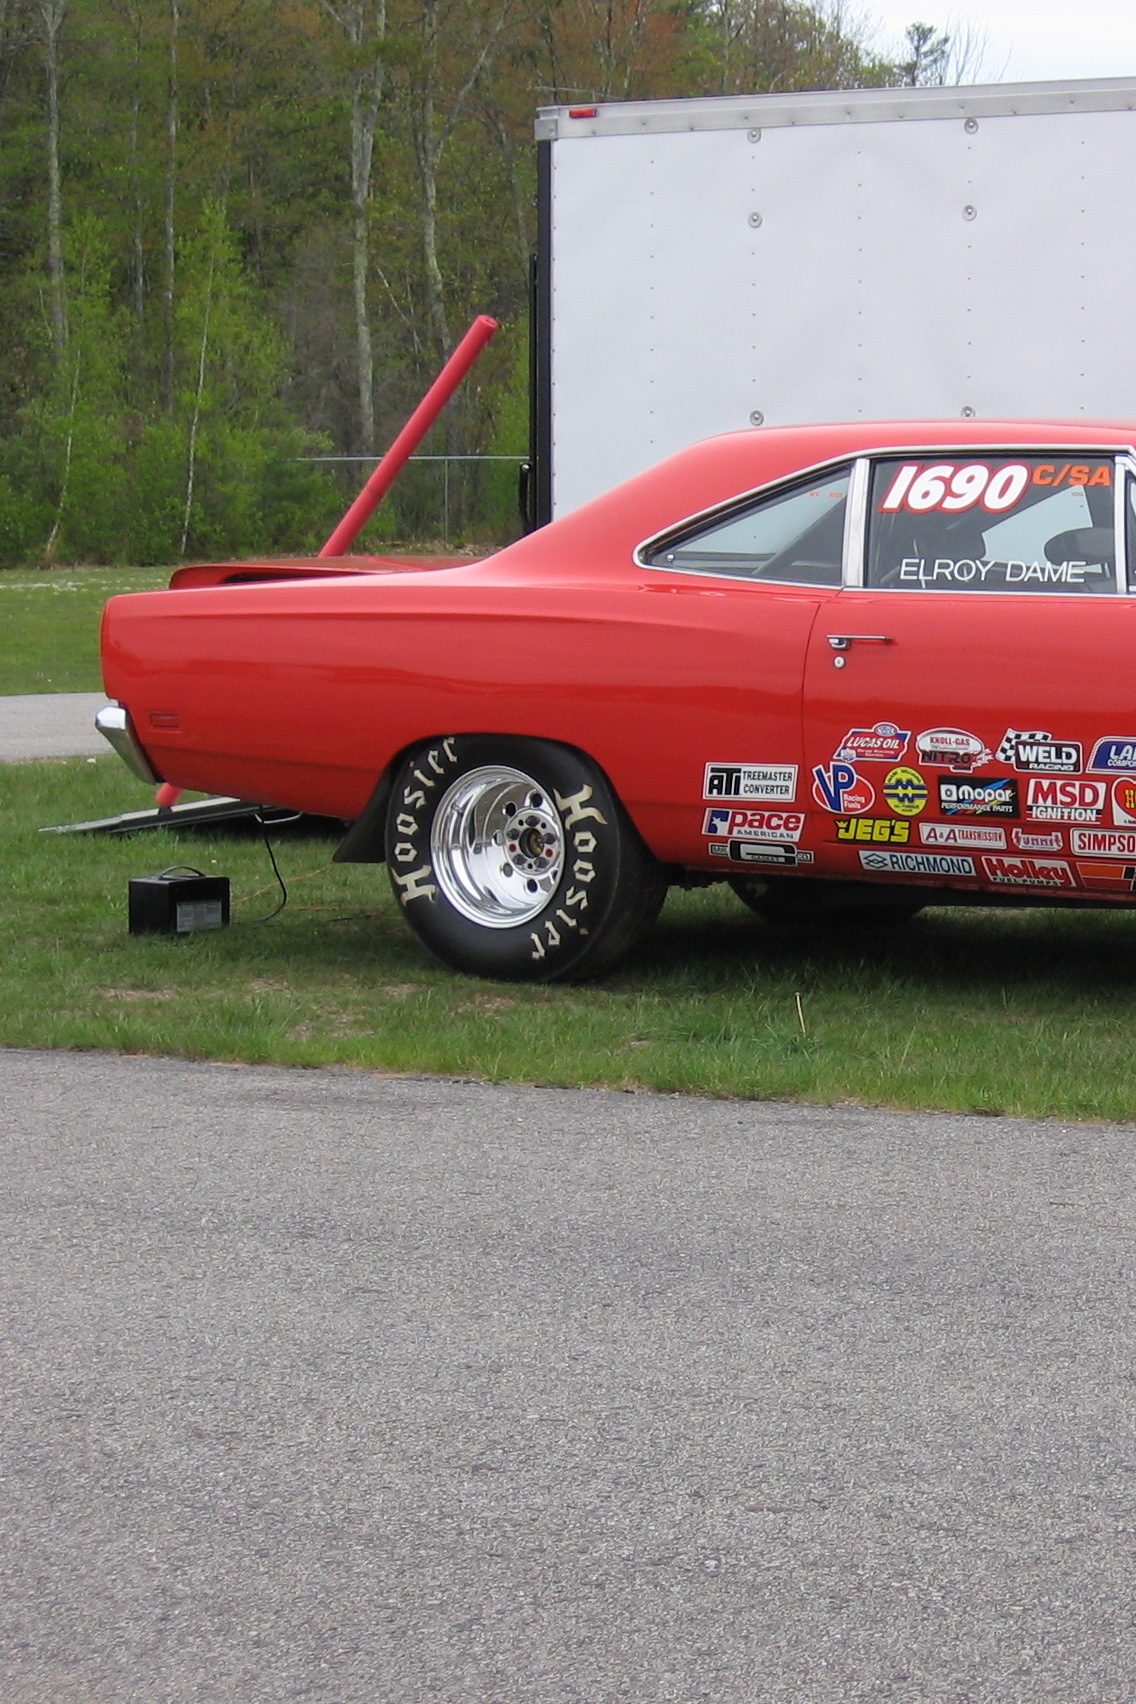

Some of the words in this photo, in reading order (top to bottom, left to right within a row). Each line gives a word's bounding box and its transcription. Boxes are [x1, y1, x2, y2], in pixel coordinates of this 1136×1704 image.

[878, 461, 1033, 514] 1690
[1032, 464, 1112, 487] C/SA
[900, 558, 995, 581] ELROY
[1005, 560, 1087, 583] DAME
[847, 736, 882, 748] LUCAS
[882, 738, 900, 749] OIL
[922, 751, 971, 763] NITRO
[1017, 744, 1078, 764] WELD
[742, 770, 793, 781] TREEMASTER
[1029, 763, 1075, 771] RACING
[708, 767, 742, 795] ATI
[743, 783, 790, 795] CONVERTER
[814, 762, 855, 812] VP
[843, 793, 865, 804] Racing
[1032, 780, 1100, 807] MSD
[844, 801, 862, 809] Fuels
[941, 802, 991, 812] PERFORMANCE
[992, 805, 1013, 813] PARTS
[1032, 806, 1097, 822] IGNITION
[391, 736, 458, 907] Hoosier
[727, 810, 802, 835] pace
[836, 818, 910, 843] JEG'S
[736, 829, 795, 839] AMERICAN
[530, 783, 608, 960] Hoosier
[891, 853, 973, 875] RICHMOND
[984, 857, 1072, 887] Holley
[1022, 878, 1059, 886] PUMPS
